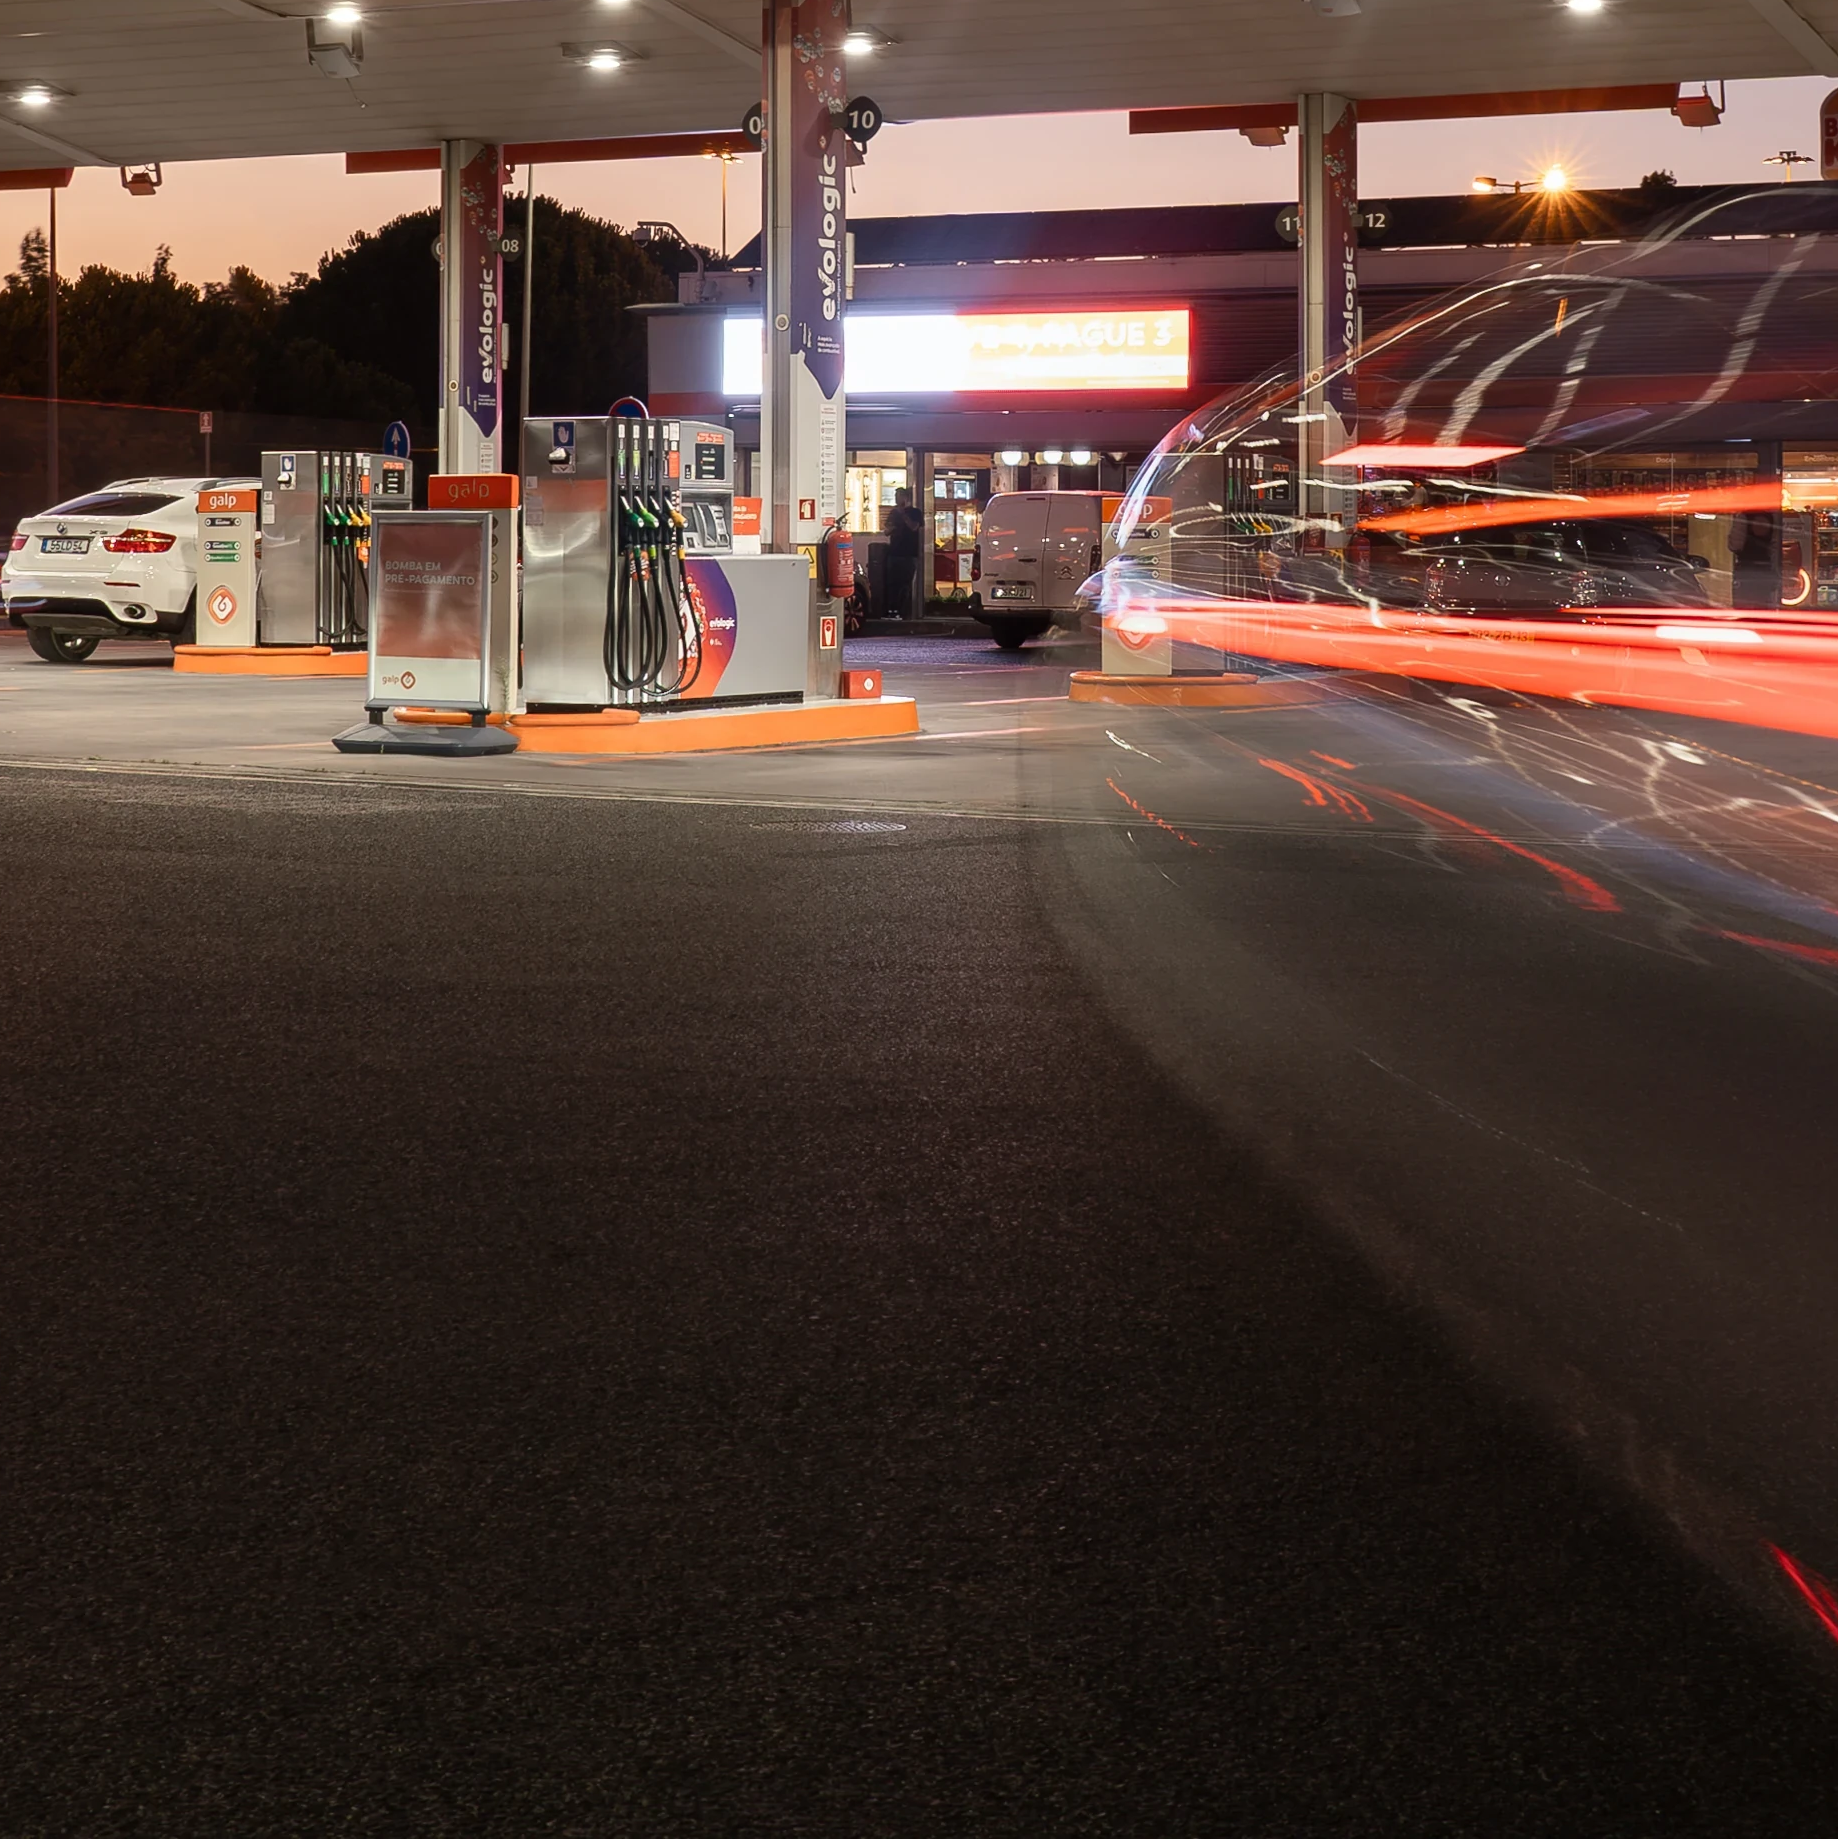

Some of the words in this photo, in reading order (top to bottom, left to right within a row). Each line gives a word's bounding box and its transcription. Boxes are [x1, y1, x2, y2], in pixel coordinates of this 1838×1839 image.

[848, 110, 875, 130] 10
[1365, 211, 1386, 229] 12
[501, 239, 519, 253] 08
[817, 153, 841, 321] evologic
[1342, 246, 1357, 375] evologic
[478, 268, 497, 384] evologic
[1153, 318, 1174, 347] 3
[447, 478, 490, 503] galp
[209, 492, 237, 510] galp
[385, 560, 423, 571] BOMBA
[425, 561, 441, 571] EM
[384, 572, 476, 586] PRÉ-PAGAMENTO
[382, 674, 400, 685] galp
